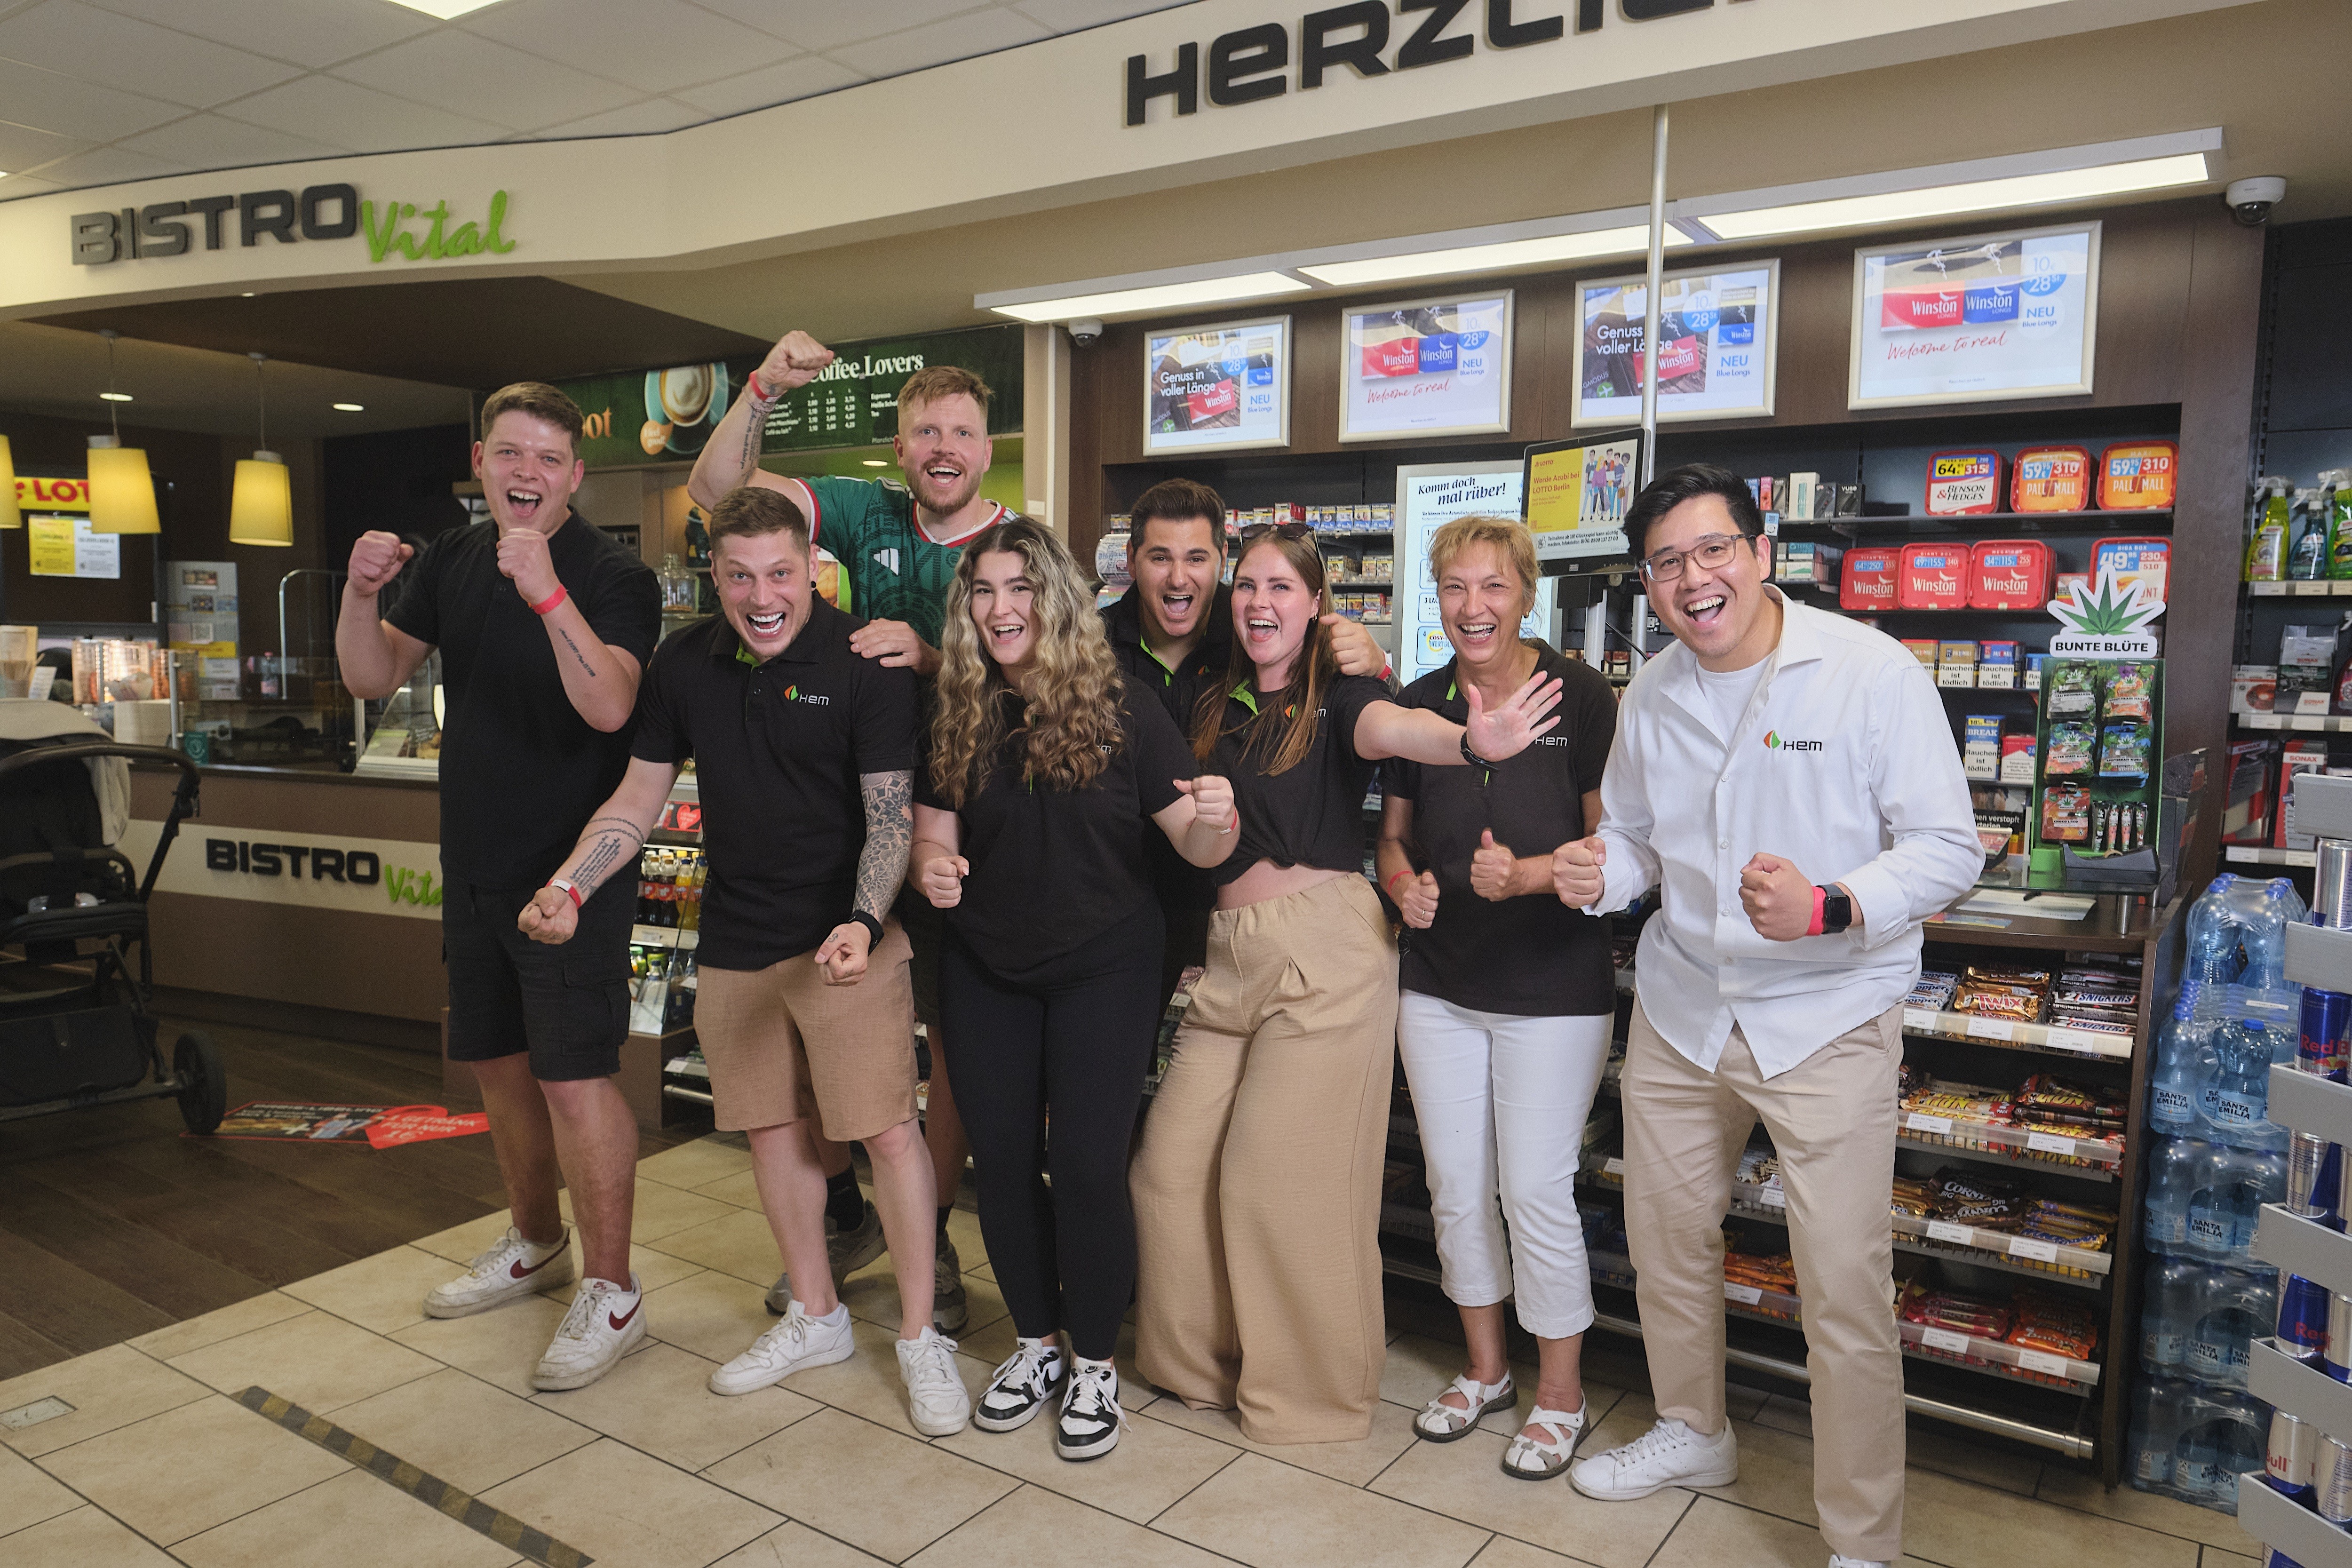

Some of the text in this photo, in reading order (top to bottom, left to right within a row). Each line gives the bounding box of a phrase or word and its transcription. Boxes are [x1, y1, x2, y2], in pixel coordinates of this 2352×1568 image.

[70, 183, 516, 266] BISTRO Vital
[2028, 276, 2050, 293] 28
[1912, 300, 1957, 315] Winston
[1966, 294, 2012, 310] Winston
[2026, 306, 2055, 318] NEU
[1691, 313, 1709, 328] 28
[1597, 325, 1643, 339] Genuss
[1731, 330, 1751, 339] Winston
[1463, 333, 1478, 347] 28
[1596, 339, 1630, 355] voller
[1887, 330, 2009, 360] Welcome to real
[1383, 354, 1414, 366] Winston
[1420, 349, 1453, 362] Winston
[1658, 351, 1694, 370] Winston
[1720, 355, 1748, 367] NEU
[864, 354, 924, 377] Lovers
[1227, 359, 1241, 372] 28
[1462, 358, 1482, 368] NEU
[1160, 368, 1205, 384] Genuss in
[1732, 369, 1751, 377] Longs
[1160, 382, 1216, 397] voller Länge
[1367, 378, 1451, 404] Welcome to real
[1204, 391, 1232, 409] Winston
[1250, 394, 1271, 405] NEU
[1938, 463, 1956, 475] 64
[2054, 462, 2079, 474] 310
[2112, 460, 2130, 476] 59
[2143, 457, 2169, 470] 310
[1534, 471, 1580, 484] Werde Azubi bei
[2025, 464, 2042, 479] 59
[32, 479, 89, 503] LOT
[1418, 477, 1476, 495] Komm doch
[1533, 483, 1570, 494] LOTTO Berlin
[1947, 485, 1986, 493] BENSON
[2027, 482, 2075, 496] PALL MALL
[2113, 478, 2164, 492] PALL MALL
[1438, 483, 1506, 505] mal rüber!
[1937, 489, 1947, 499] &
[2099, 552, 2128, 568] 49
[1853, 580, 1893, 595] Winston
[1913, 577, 1956, 592] Winston
[1983, 576, 2028, 591] Winston
[2055, 640, 2148, 652] BUNTE BLÜTE
[799, 693, 829, 706] Hem
[1783, 740, 1822, 751] Hem
[2238, 743, 2261, 751] SONAX
[1988, 814, 2020, 824] verstopft
[206, 838, 443, 906] BISTRO Vita
[1973, 994, 2025, 1011] Twix
[2079, 993, 2133, 1003] SNICKERS
[2072, 1022, 2126, 1033] SNICKERS
[2301, 1034, 2335, 1054] Red
[2036, 1093, 2084, 1106] LION
[2157, 1098, 2188, 1109] EMILIA
[2159, 1091, 2187, 1102] SANTA
[2219, 1106, 2250, 1120] EMILIA
[2221, 1100, 2249, 1112] SANTA
[1944, 1181, 1985, 1200] CORNY
[2193, 1218, 2221, 1231] SANTA
[2192, 1226, 2222, 1238] EMILIA
[2234, 1351, 2249, 1360] SAN
